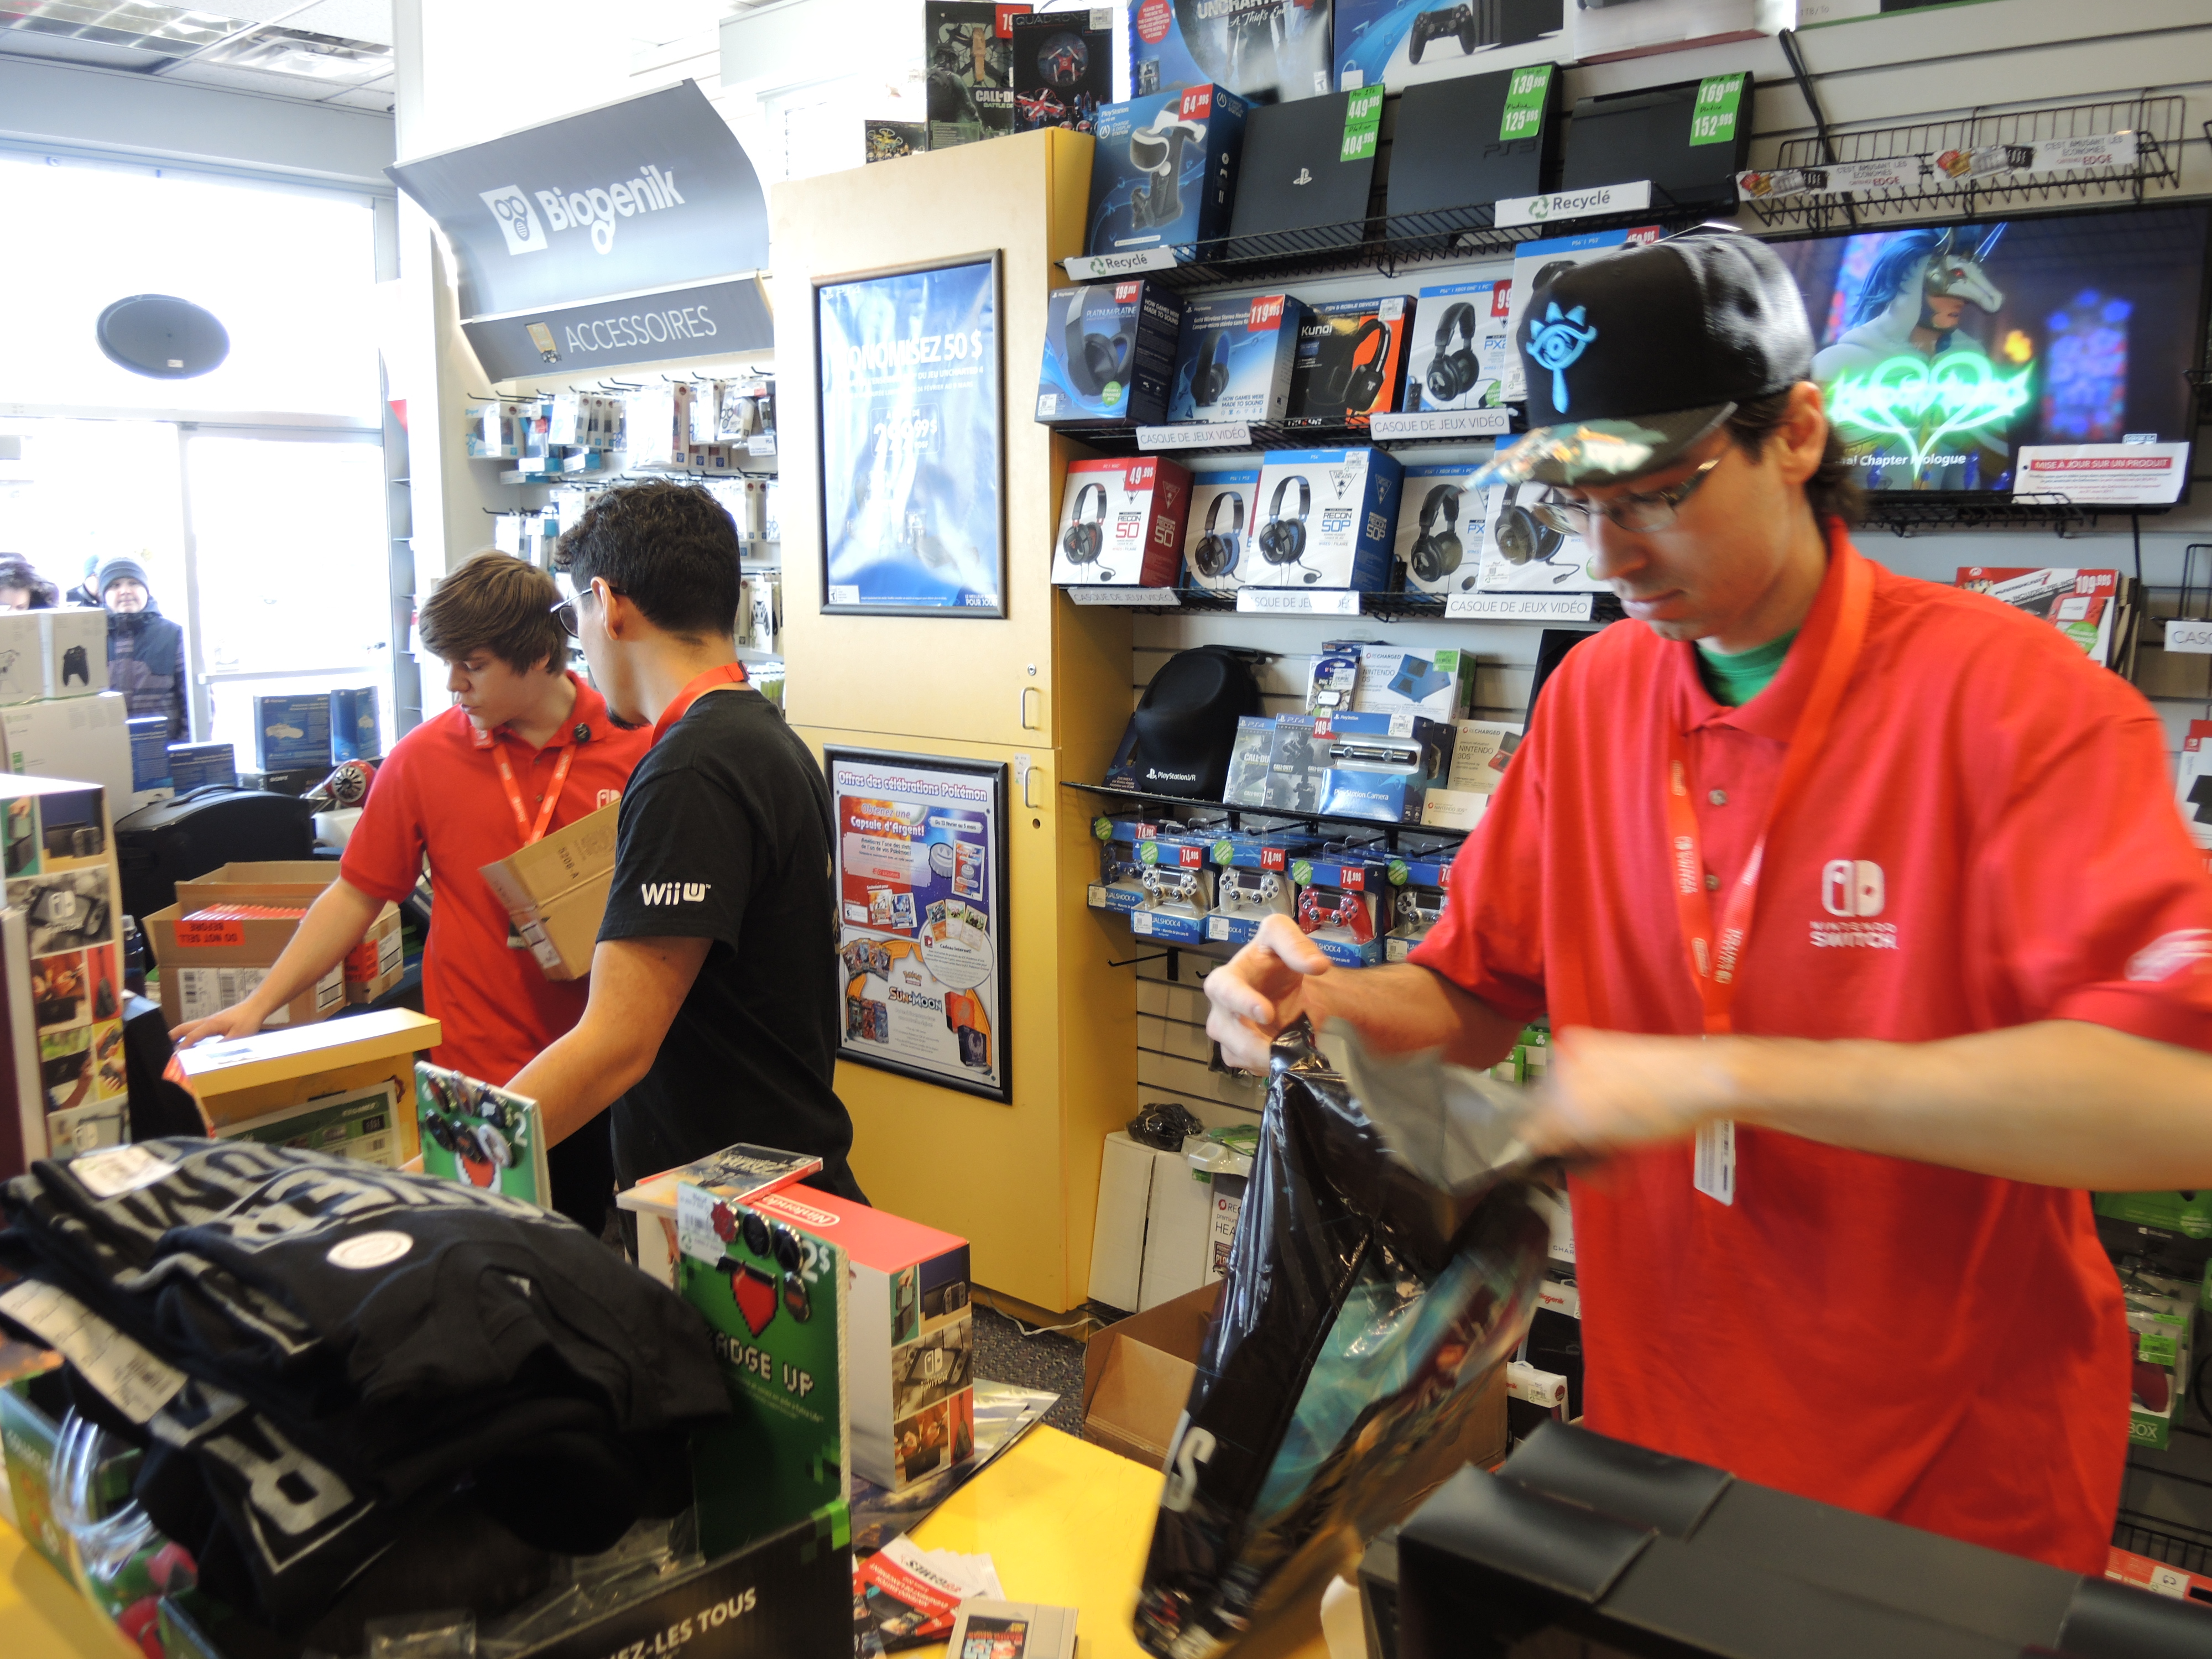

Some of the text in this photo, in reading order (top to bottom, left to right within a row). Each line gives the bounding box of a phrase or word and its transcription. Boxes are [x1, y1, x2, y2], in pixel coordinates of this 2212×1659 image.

[1015, 13, 1087, 26] QUADRONE
[1243, 10, 1267, 26] Thief's
[1512, 74, 1546, 95] 139.99$
[1700, 81, 1740, 104] 169.99$
[975, 90, 1001, 103] CALL
[1101, 106, 1129, 118] PlayStation
[1349, 95, 1380, 118] 449.99$
[1505, 109, 1538, 132] 125.99$
[1694, 112, 1734, 138] 152.99$
[1343, 132, 1375, 154] 404.99$
[1484, 140, 1536, 158] PS3
[2069, 138, 2105, 148] AMUSANT
[2109, 135, 2123, 145] LES
[2083, 154, 2113, 165] EDGE
[1873, 176, 1900, 186] EDGE
[1553, 190, 1610, 210] Recyclé
[535, 164, 685, 255] Biogenik
[1106, 254, 1147, 271] Recyclé
[836, 285, 861, 298] PS4
[565, 306, 717, 353] ACCESSOIRES
[1301, 324, 1332, 336] Kunai
[848, 328, 983, 372] ONOMISEZ 50 $
[918, 371, 927, 380] DU
[928, 370, 938, 379] JEU
[939, 367, 978, 378] UNCHARTED
[924, 384, 945, 392] FÉVRIER
[1375, 414, 1505, 433] CASQUE DE JEUX VIDÉO
[1140, 427, 1246, 444] CASQUE DE JEUX VIDÉO
[1860, 455, 1908, 468] Chapter
[2034, 458, 2168, 469] MISE JOUR SUR UN PRODUIT
[1129, 467, 1154, 485] 49.99$
[1115, 523, 1140, 539] 50
[1156, 519, 1176, 531] RECON
[1321, 520, 1351, 532] 50P
[1366, 525, 1385, 541] 50P
[1154, 527, 1174, 547] 50
[1074, 593, 1109, 602] CASQUE
[1111, 592, 1123, 602] DE
[1283, 598, 1296, 607] DE
[2013, 589, 2047, 601] INCLUDED
[1451, 600, 1587, 614] CASQUE DE JEUX VIDÉO
[2171, 630, 2212, 645] CAS
[1459, 745, 1494, 754] NINTENDO
[838, 771, 987, 801] Offres des célébrations Pokémon
[1334, 788, 1365, 799] PlayStation
[861, 804, 910, 819] Obtenez une
[851, 816, 925, 837] Capsule d'Argent!
[1182, 849, 1199, 862] 74.99$
[1263, 850, 1282, 865] 74.99$
[1342, 870, 1361, 885] 74.99$
[641, 882, 706, 906] Wii U
[1809, 931, 1900, 950] SWITCH
[912, 992, 943, 1014] MOON
[763, 1194, 831, 1224] Nintendo
[716, 1332, 772, 1381] ADGE
[782, 1362, 815, 1399] UP
[920, 1374, 949, 1393] SWITCH
[697, 1587, 756, 1634] TOUS
